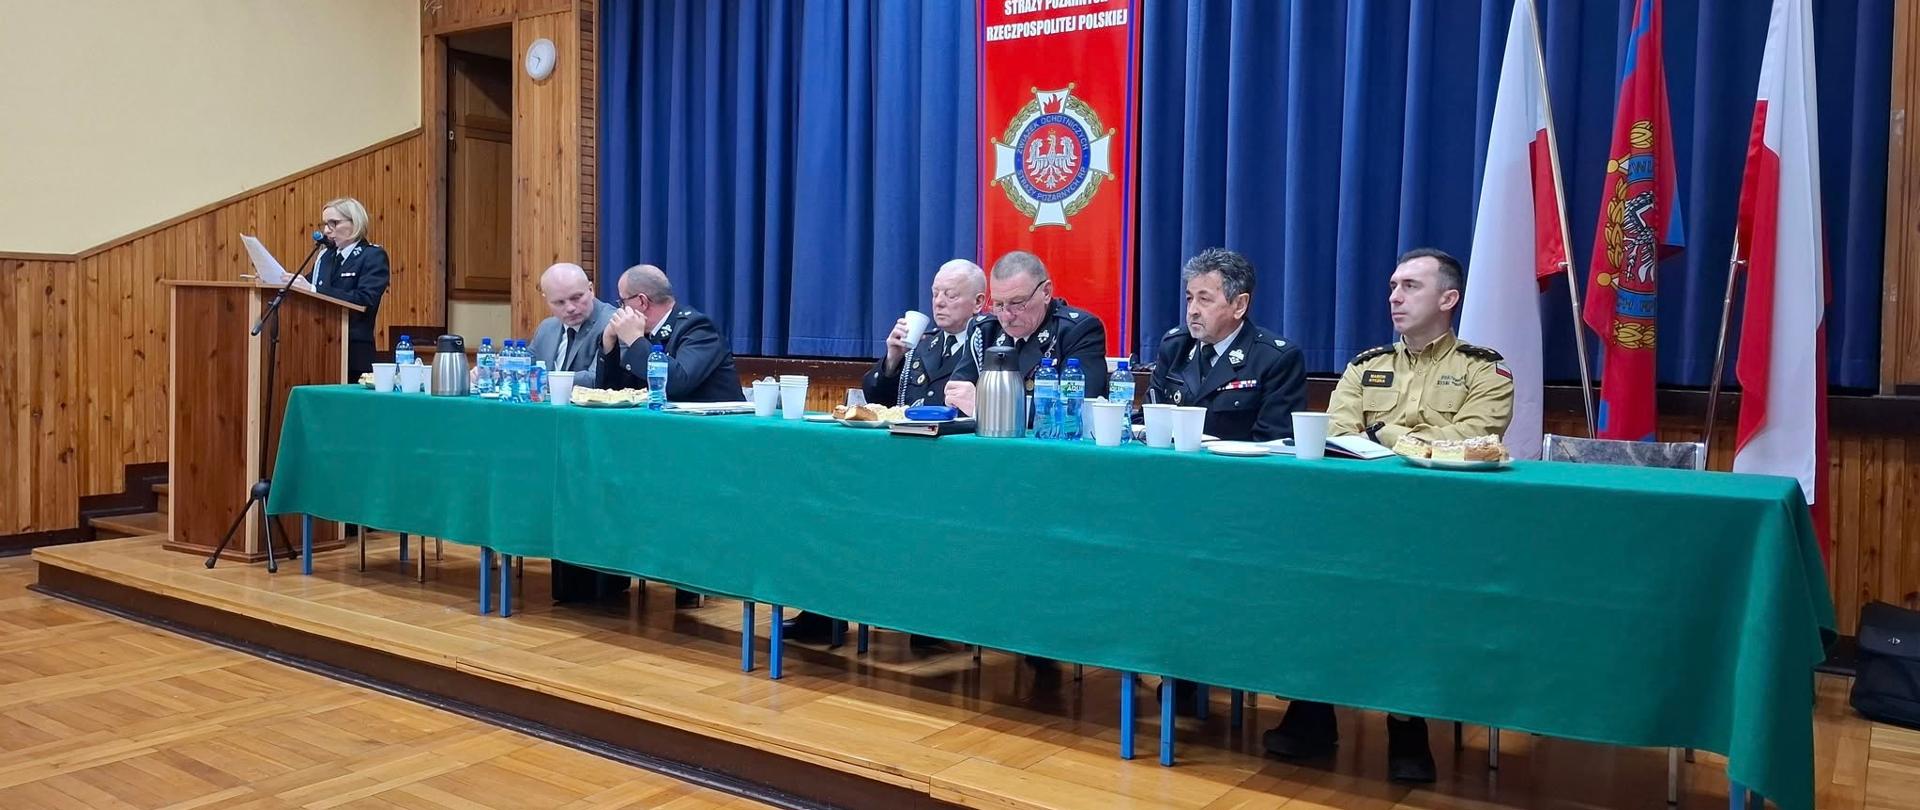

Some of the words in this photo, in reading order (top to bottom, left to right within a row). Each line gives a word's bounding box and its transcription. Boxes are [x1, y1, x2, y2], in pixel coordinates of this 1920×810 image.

[986, 15, 1076, 41] RZECZPOSPOLITEJ
[1078, 8, 1127, 30] POLSKIEJ
[1041, 115, 1088, 150] OCHOTNICZYCH
